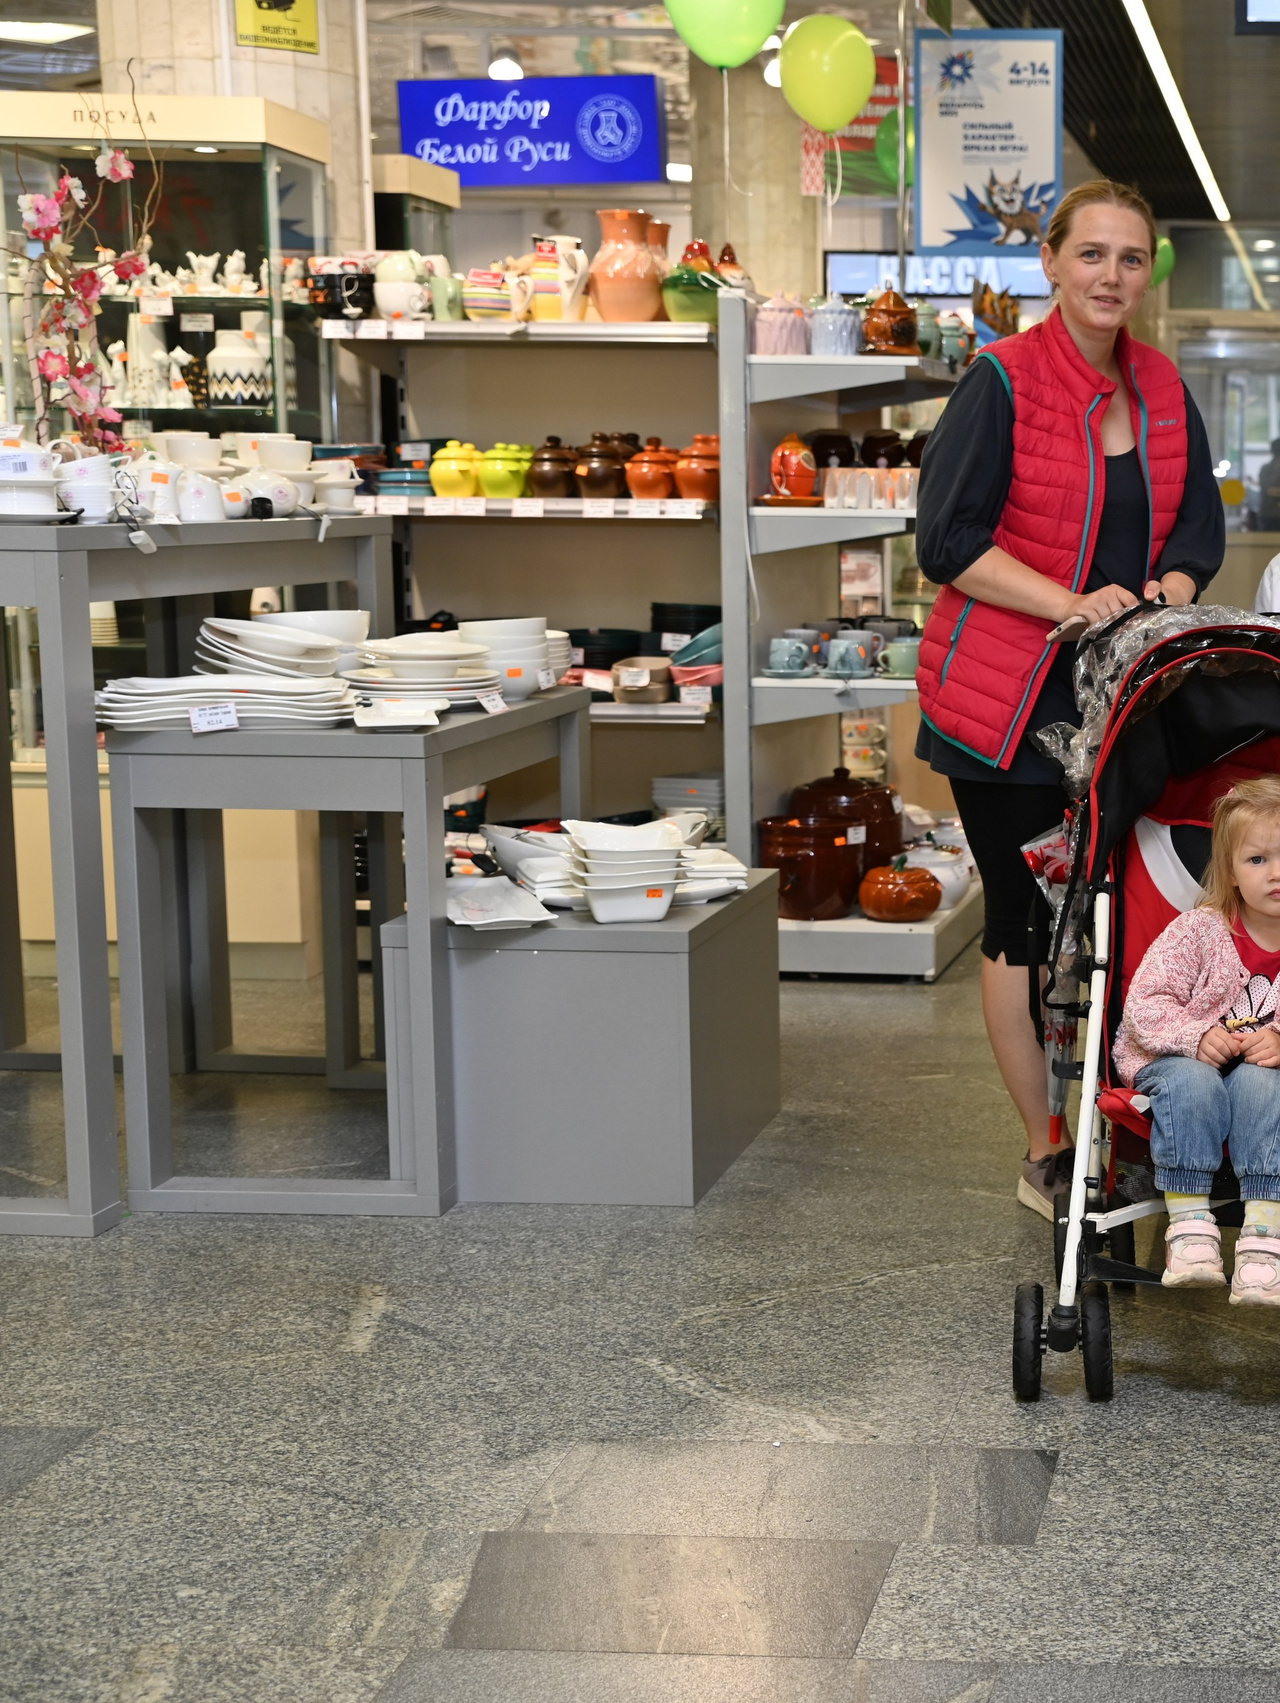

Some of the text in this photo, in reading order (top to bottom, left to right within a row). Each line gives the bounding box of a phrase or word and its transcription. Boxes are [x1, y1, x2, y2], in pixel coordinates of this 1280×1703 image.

[1009, 61, 1050, 76] 4-14
[73, 109, 157, 124] ПОСУДА
[434, 88, 550, 131] Фарфор
[415, 135, 573, 172] Белой Руси
